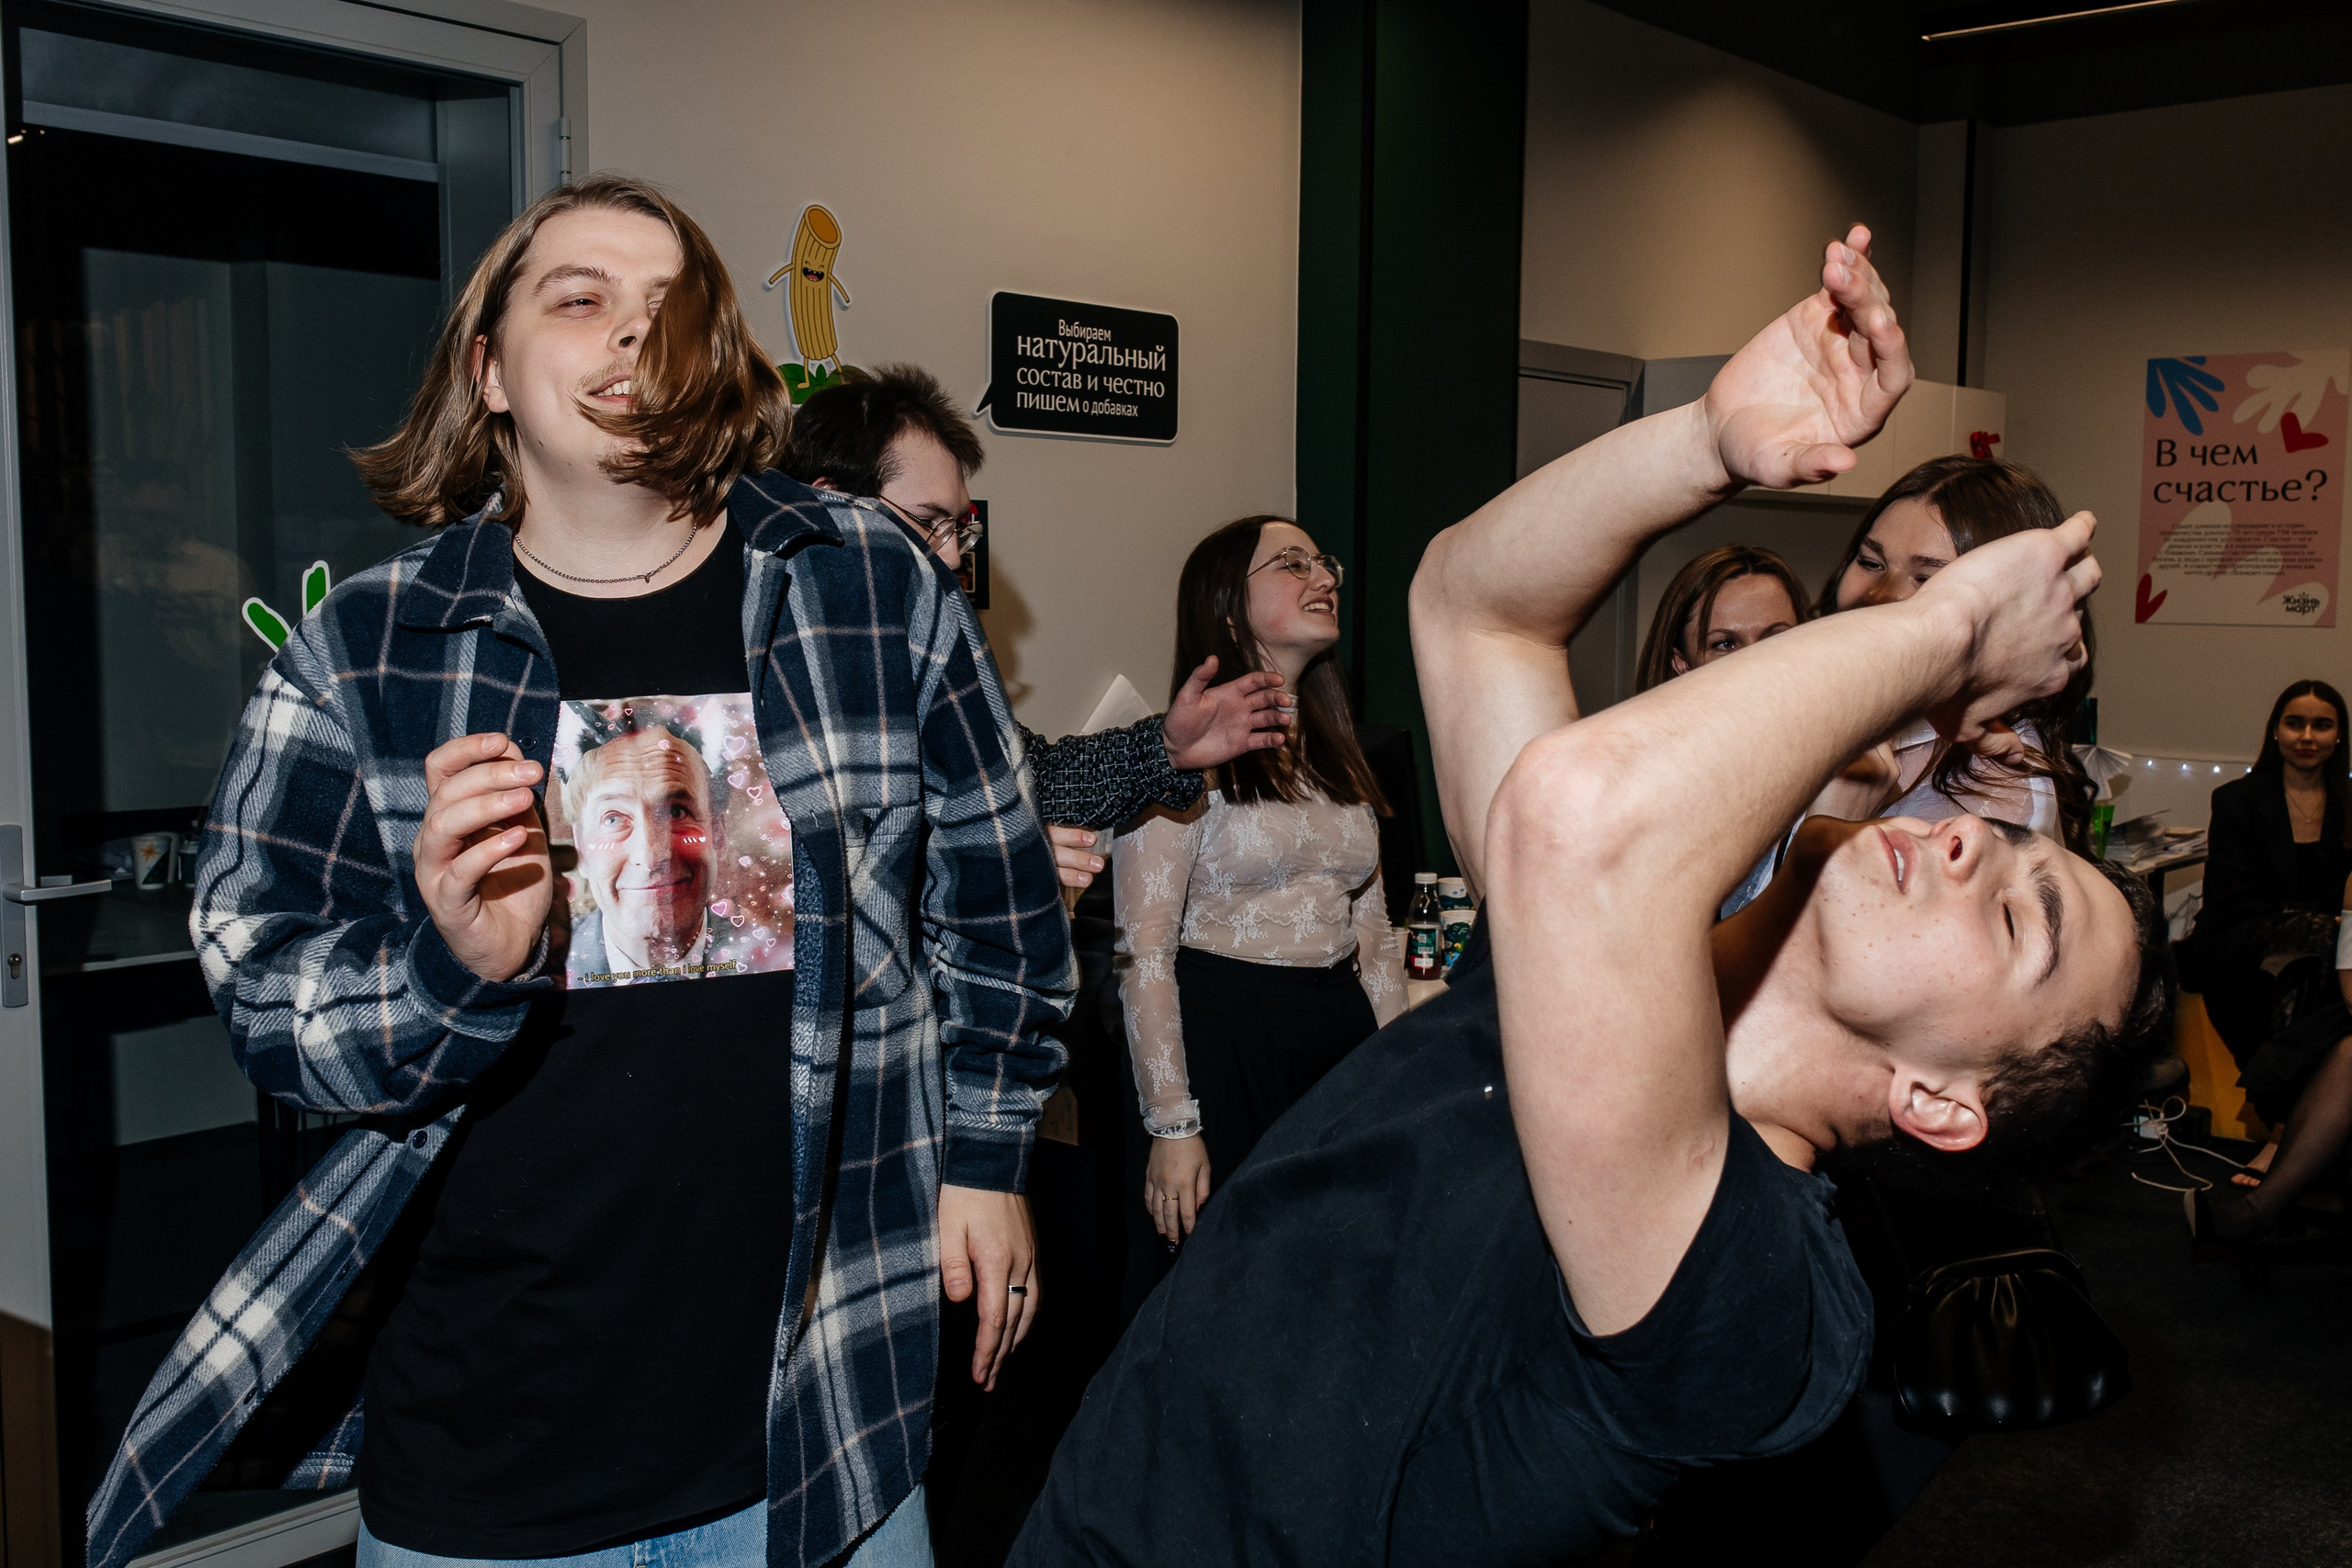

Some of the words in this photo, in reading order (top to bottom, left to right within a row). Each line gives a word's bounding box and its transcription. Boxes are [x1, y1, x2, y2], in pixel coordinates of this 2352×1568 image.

[1058, 319, 1112, 343] Выбираем
[1017, 335, 1166, 371] натуральный
[1016, 367, 1082, 389] состав
[1087, 375, 1099, 391] и
[1103, 377, 1165, 398] честно
[1016, 391, 1080, 413] пишем
[1082, 400, 1090, 413] о
[1091, 399, 1138, 417] добавках
[2155, 439, 2177, 468] В
[2190, 444, 2258, 467] чем
[2153, 468, 2328, 504] счастье?
[591, 972, 610, 982] love
[613, 972, 631, 984] you
[633, 968, 657, 977] more
[659, 965, 682, 976] than
[688, 964, 705, 974] love
[707, 959, 737, 974] myself
